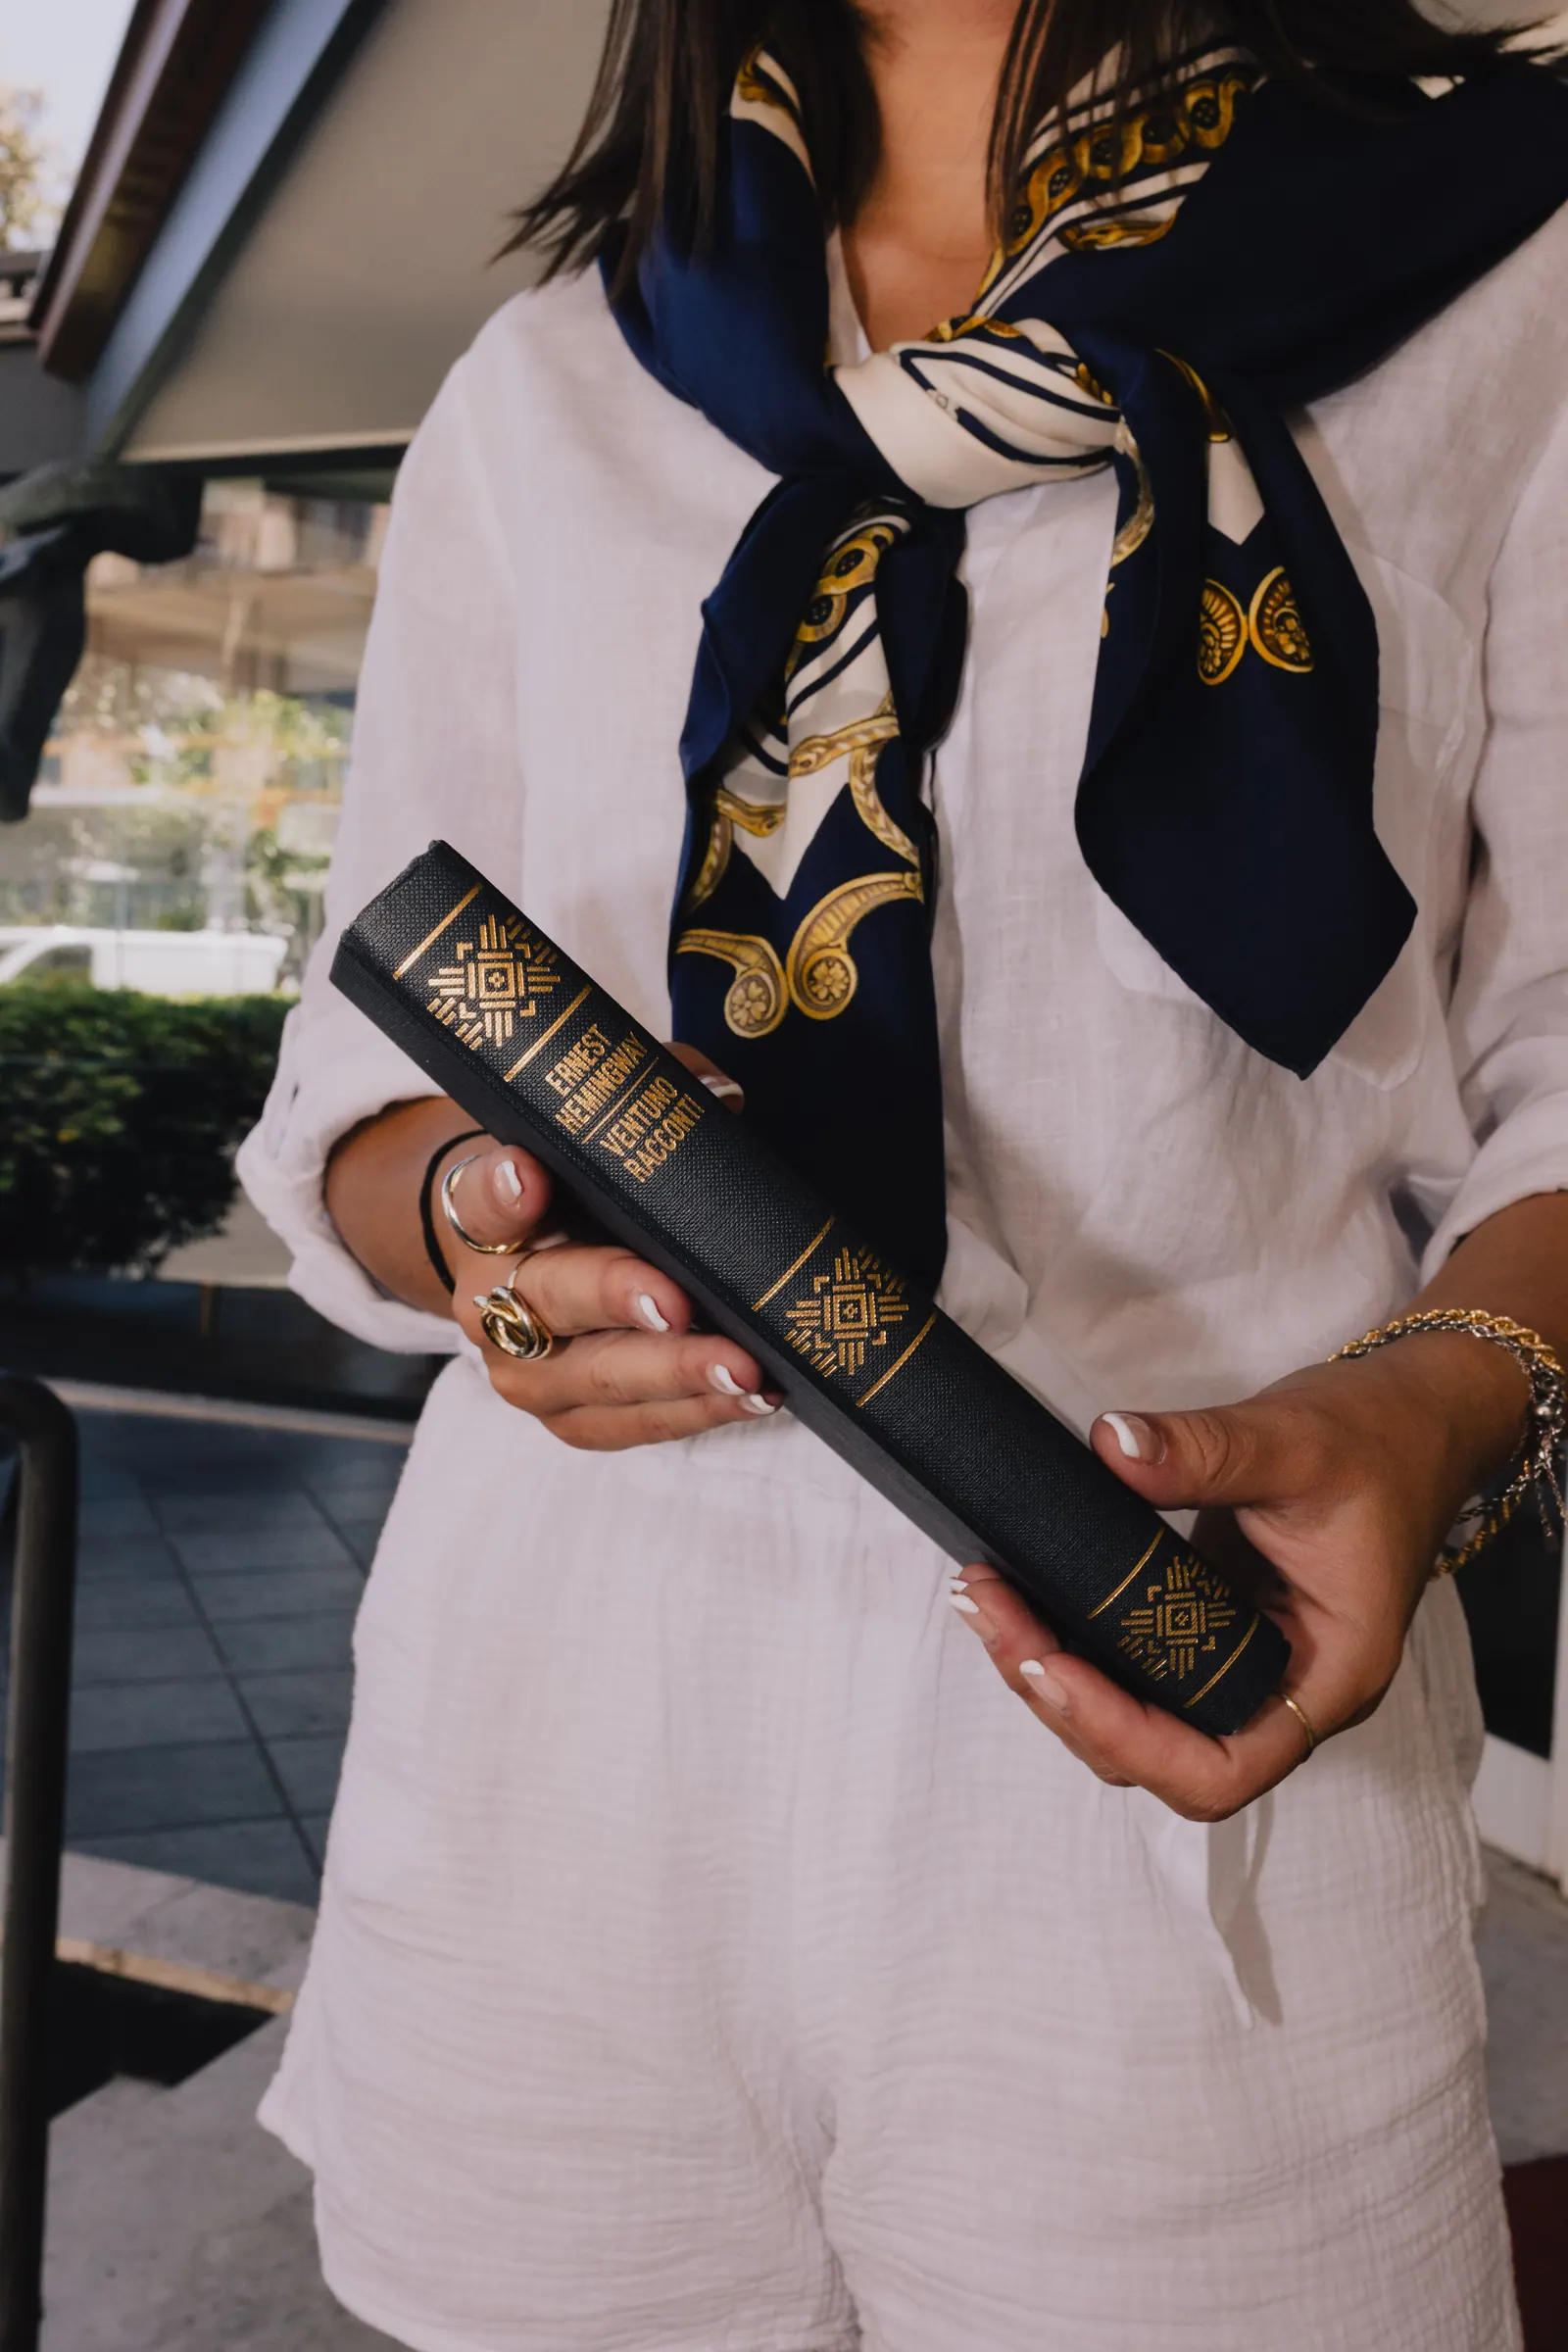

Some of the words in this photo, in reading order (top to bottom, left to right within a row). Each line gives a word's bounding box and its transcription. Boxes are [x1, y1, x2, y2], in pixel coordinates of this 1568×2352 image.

[545, 1023, 612, 1097] ERNEST
[555, 1031, 648, 1135] HEMINGWAY
[599, 1076, 678, 1156] VENTUNO
[623, 1093, 706, 1183] RACCONTI
